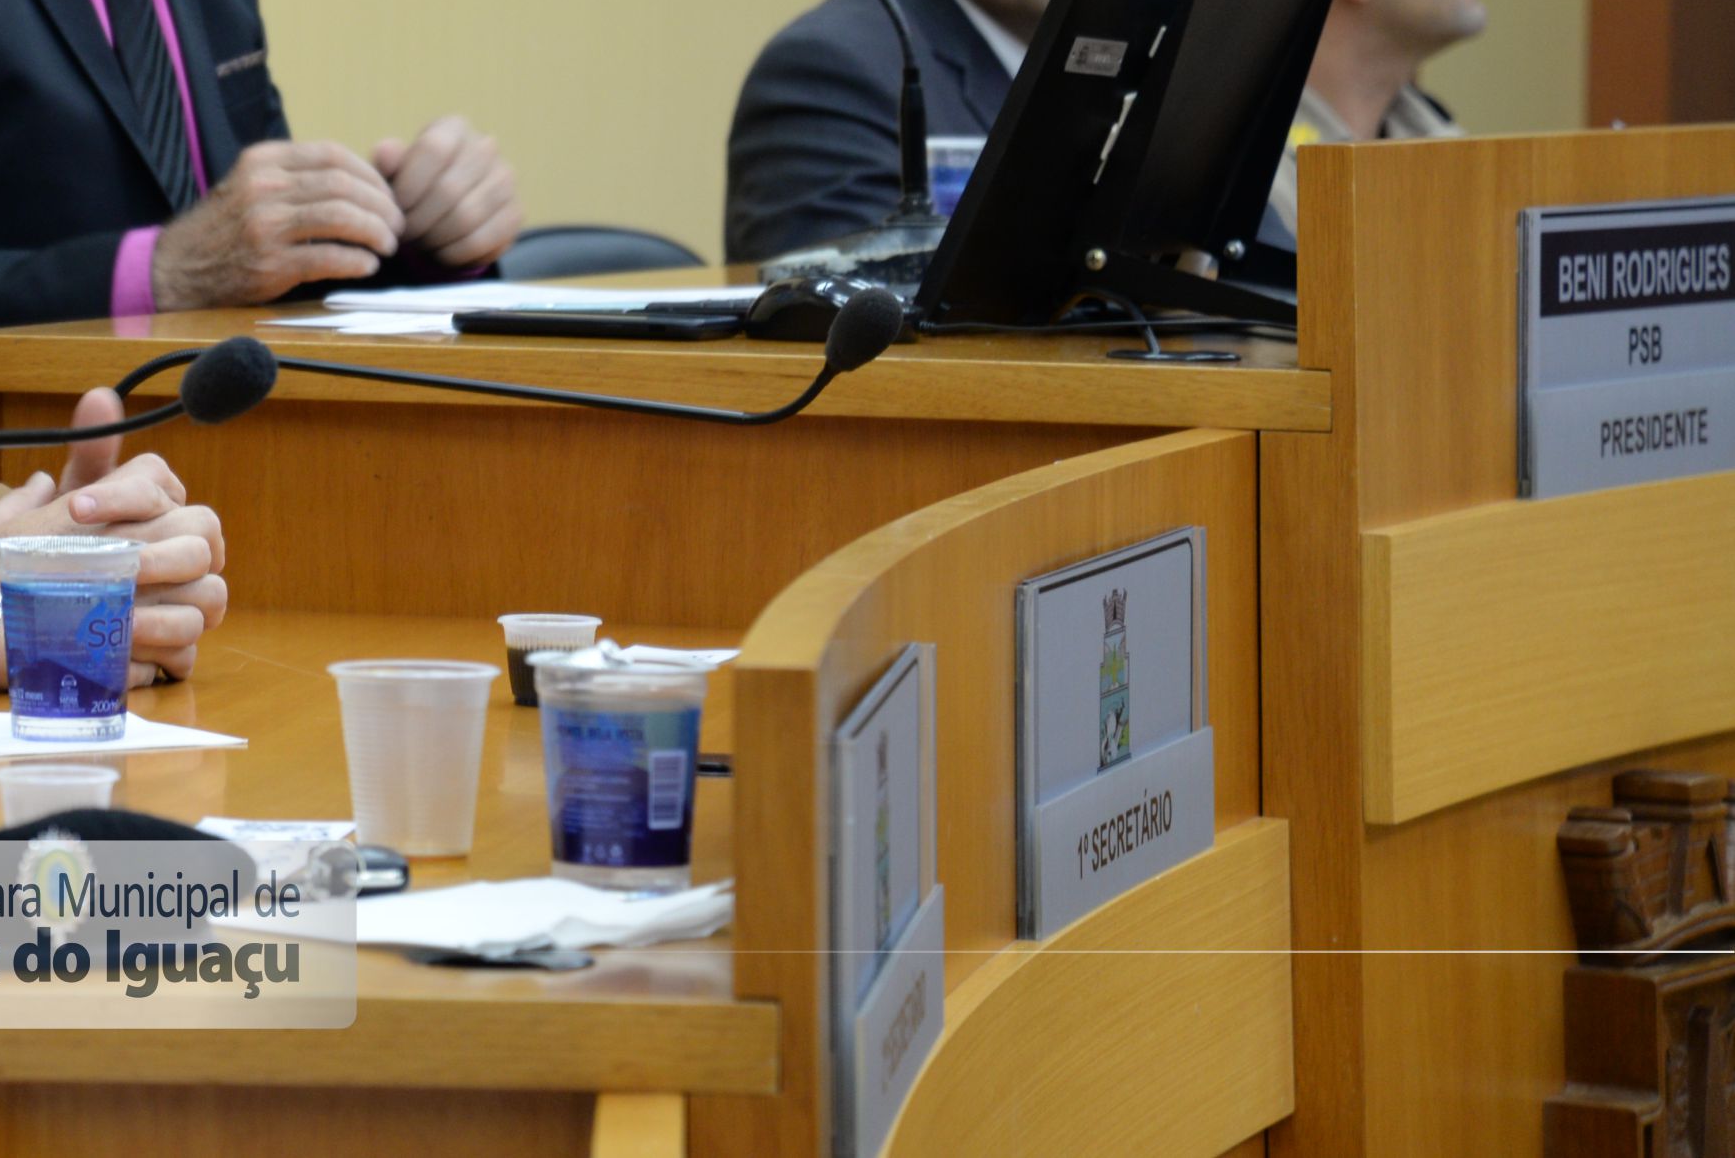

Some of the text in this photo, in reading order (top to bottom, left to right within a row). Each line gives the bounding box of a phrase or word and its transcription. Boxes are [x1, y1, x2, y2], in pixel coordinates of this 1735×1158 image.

[1558, 243, 1730, 303] BENI RODRIGUES
[1628, 323, 1663, 364] PSB
[1600, 406, 1708, 457] PRESIDENTE
[1092, 788, 1172, 872] SECRETÁRIO
